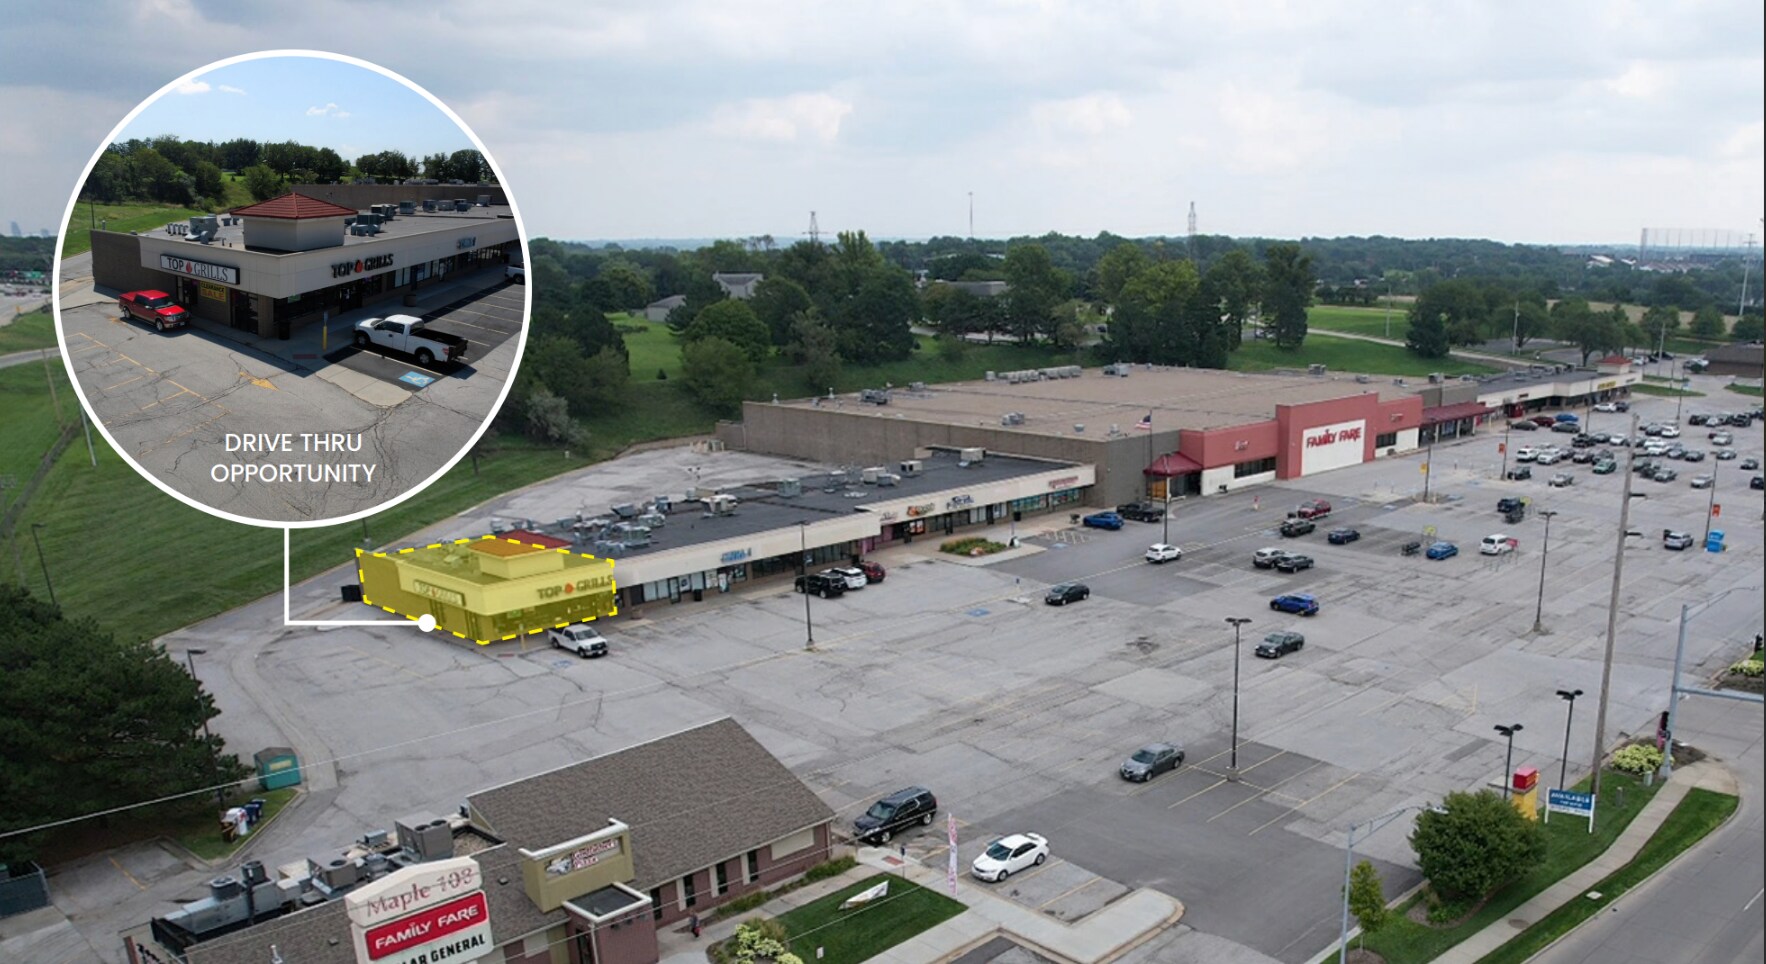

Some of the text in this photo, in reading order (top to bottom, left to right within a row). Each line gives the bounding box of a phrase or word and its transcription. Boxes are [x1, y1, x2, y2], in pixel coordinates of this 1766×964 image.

[167, 257, 228, 282] TOP GRILLS
[331, 253, 394, 278] TOP GRILLS
[1306, 427, 1362, 449] FAMILY FARE
[537, 574, 613, 600] TOP GRILLS
[367, 883, 431, 917] Maple
[375, 904, 478, 949] FAMILY FARE
[430, 933, 486, 963] GENERAL
